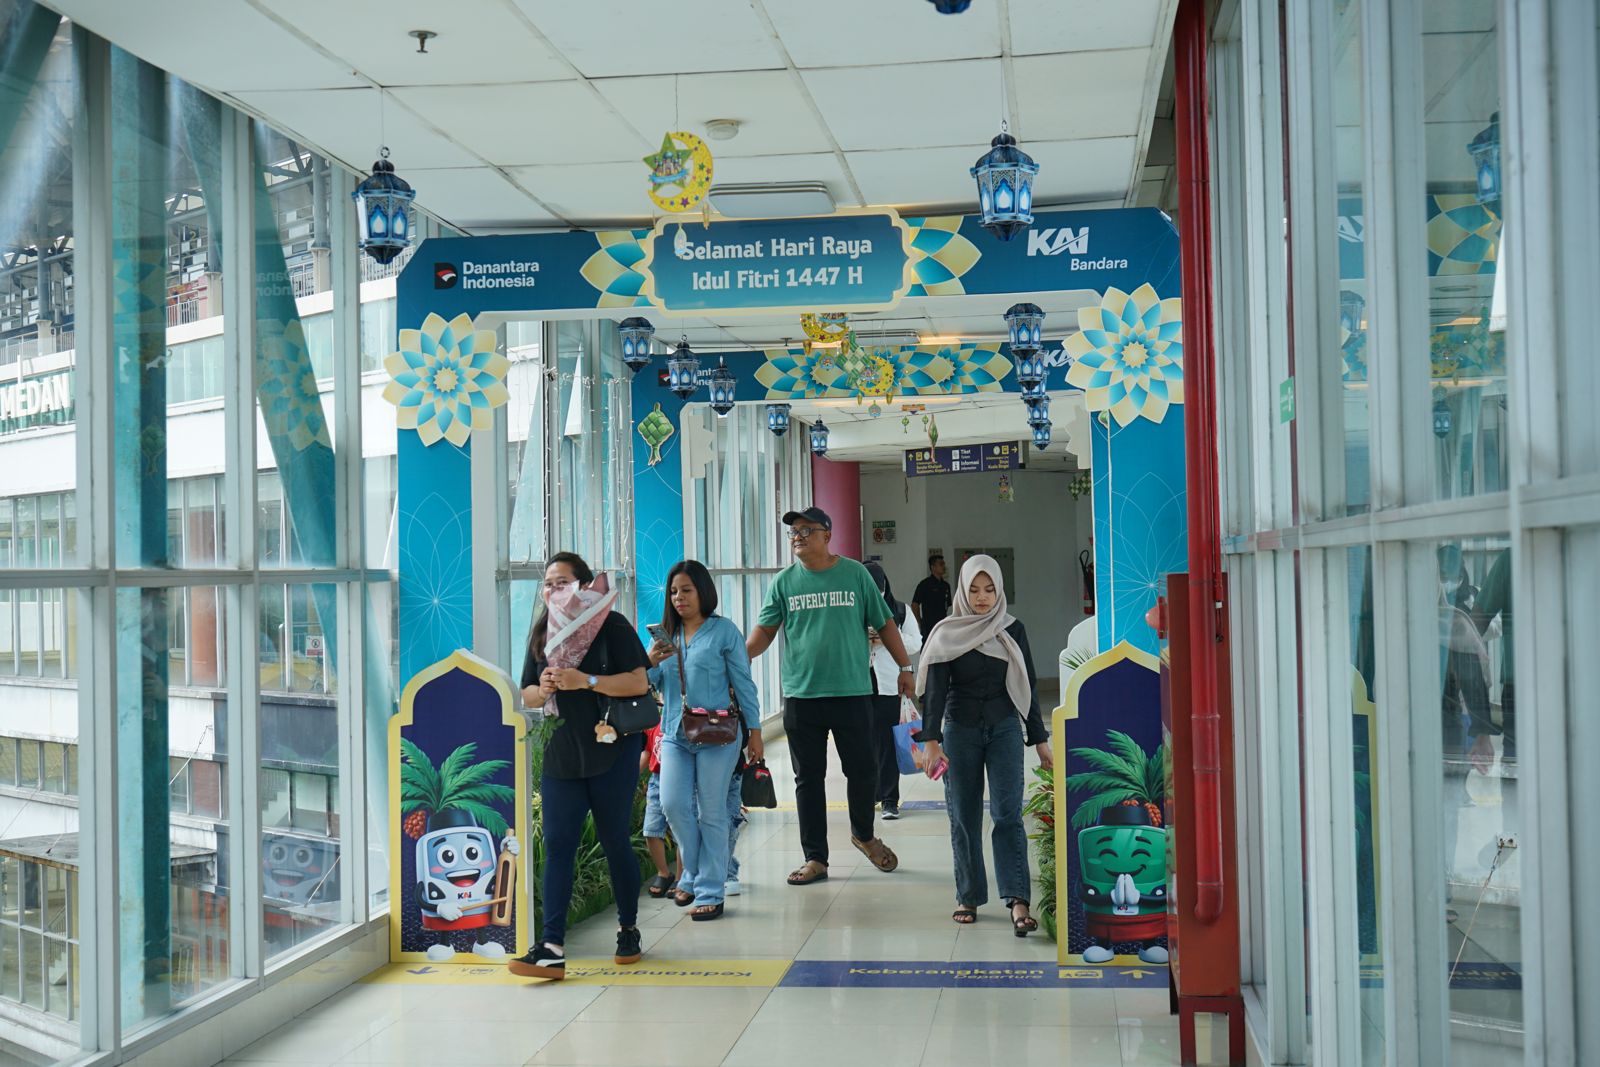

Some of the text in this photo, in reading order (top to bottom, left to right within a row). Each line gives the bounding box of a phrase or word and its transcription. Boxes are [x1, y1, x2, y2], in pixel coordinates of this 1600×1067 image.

[682, 236, 873, 261] Selamat Hari Raya
[1027, 227, 1089, 256] KAI
[462, 260, 540, 275] Danantara
[1070, 256, 1128, 271] Bandara
[462, 274, 535, 289] Indonesia
[692, 265, 863, 291] Idul Fitri 1447 H
[0, 372, 70, 420] MEDAN
[788, 591, 855, 612] BEVERLY HILLS
[848, 968, 1044, 976] Keberangkatan
